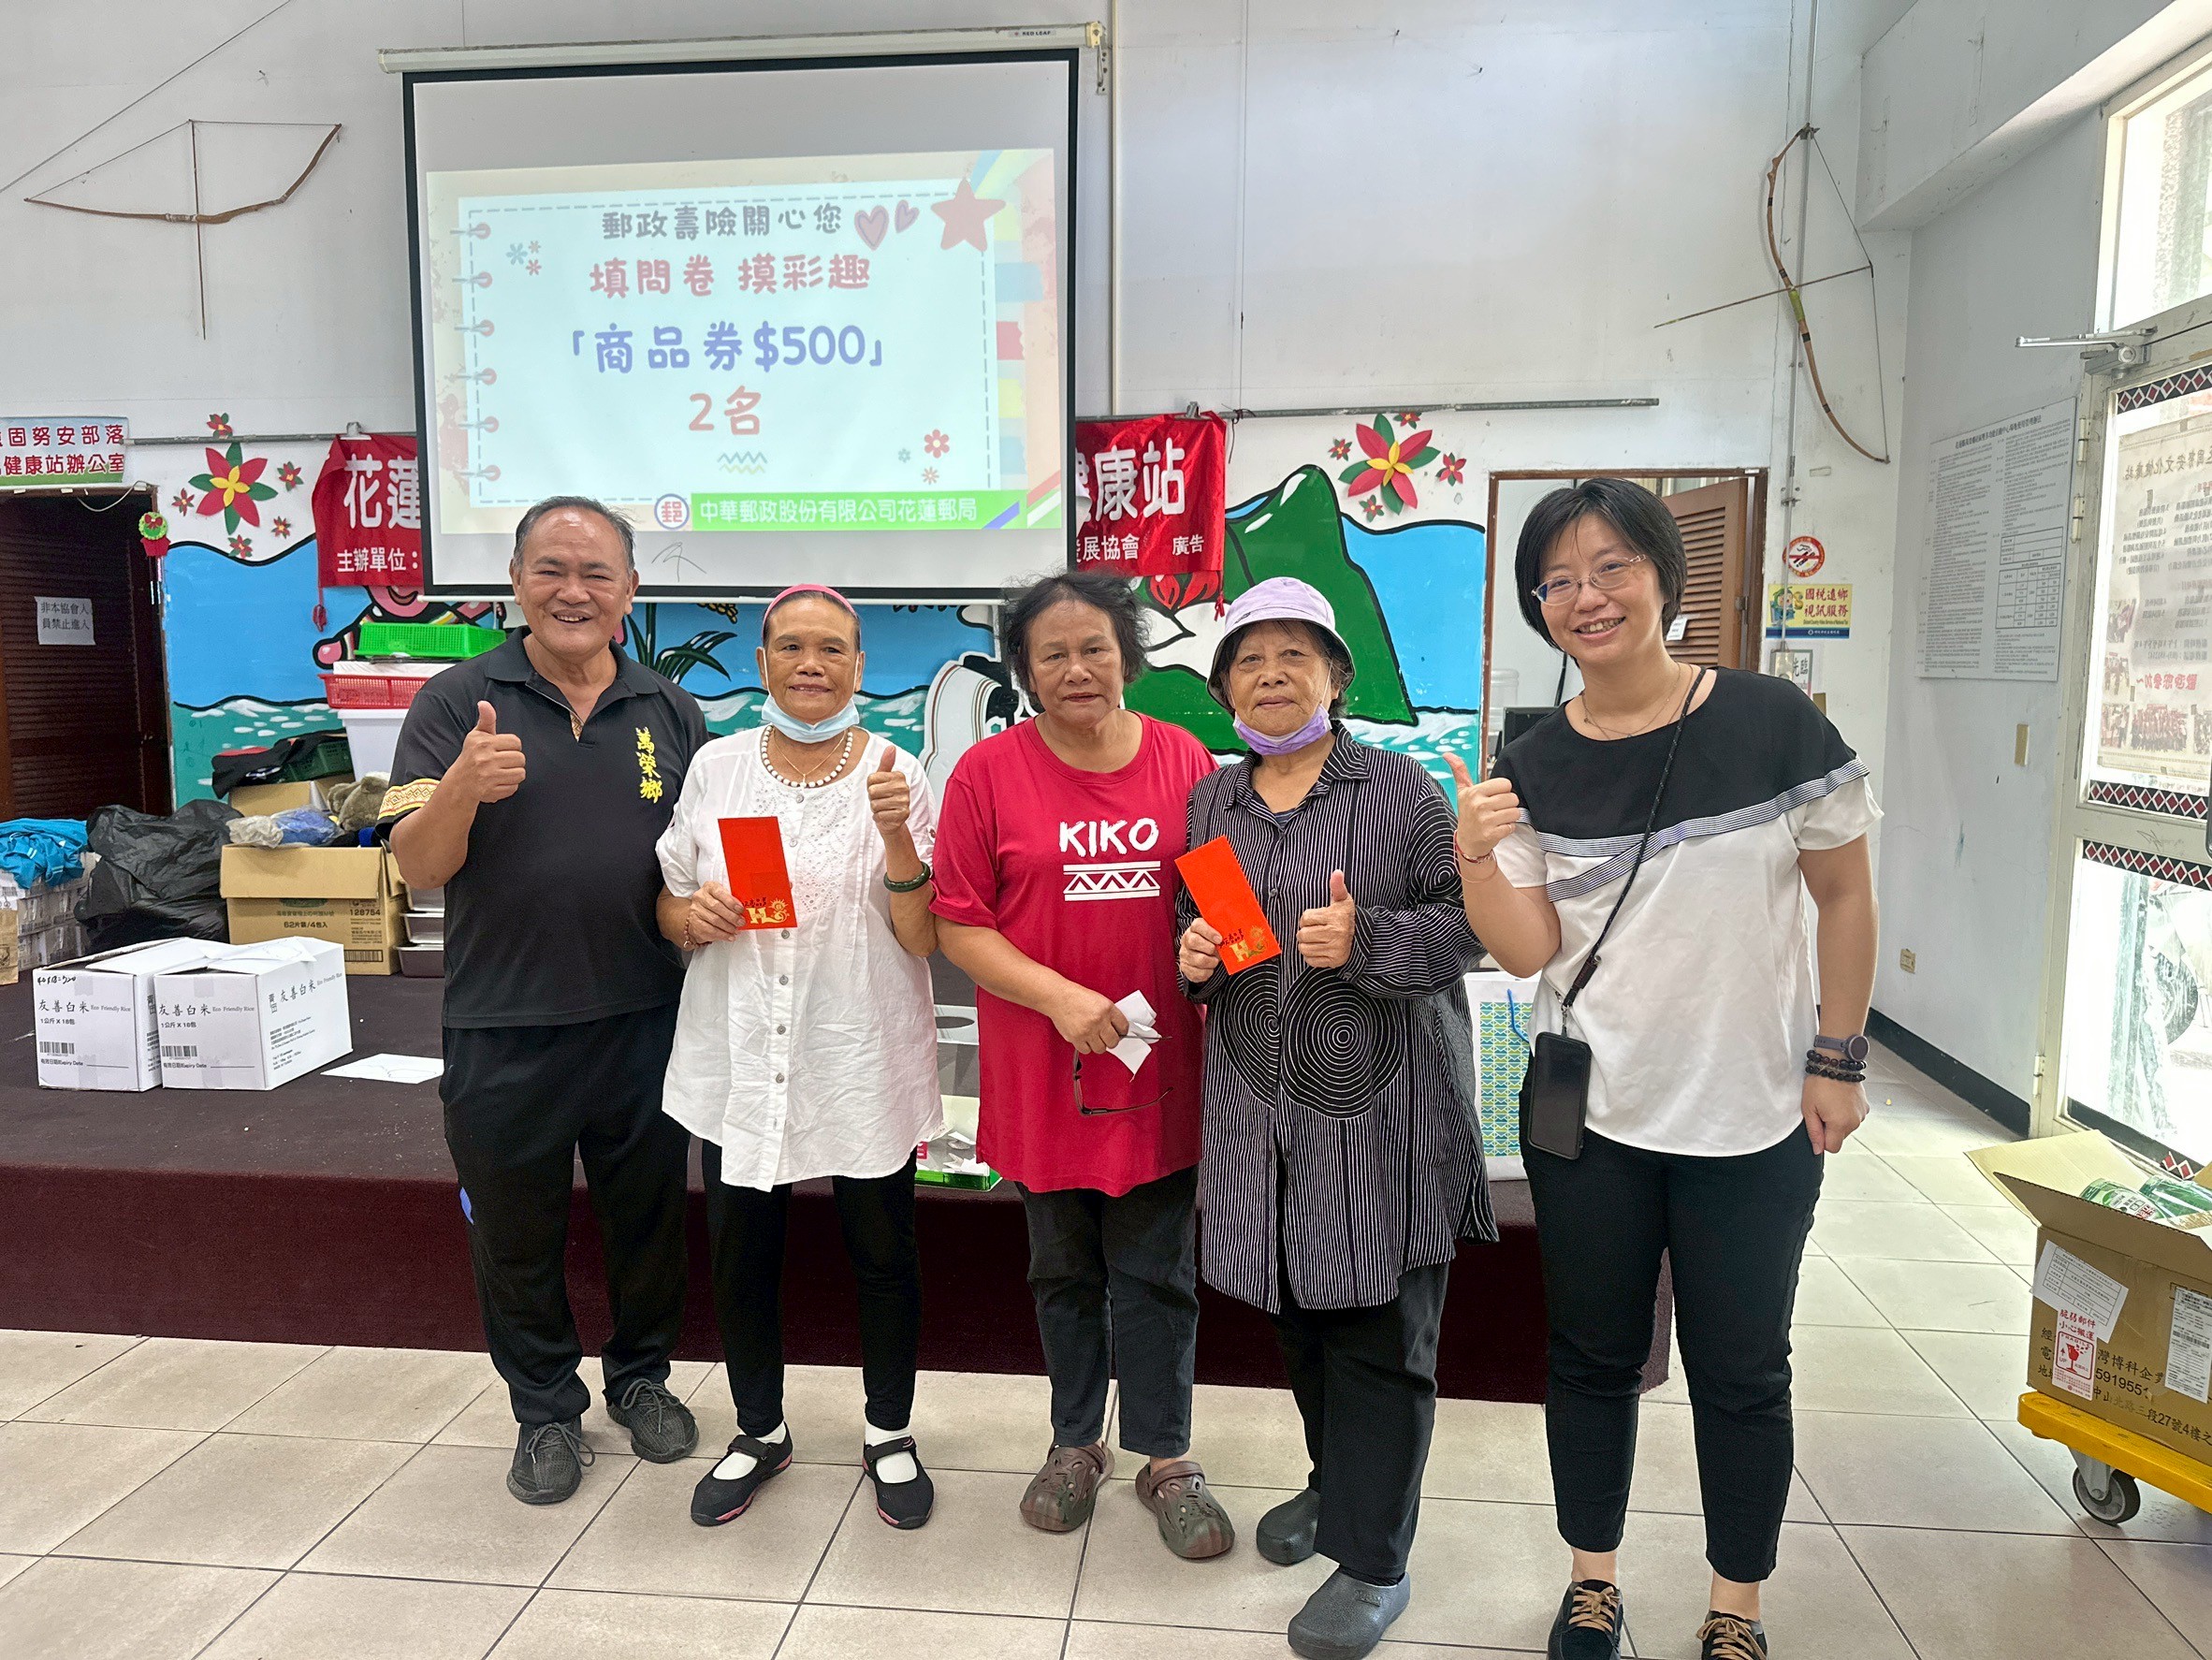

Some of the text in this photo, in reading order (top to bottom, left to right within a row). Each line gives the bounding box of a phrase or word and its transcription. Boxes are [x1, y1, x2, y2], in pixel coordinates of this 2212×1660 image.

[601, 203, 843, 240] 郵政壽險關心您
[589, 253, 870, 299] 填問卷 摸彩趣
[688, 385, 763, 436] 2名
[0, 424, 124, 447] 固努安部落
[0, 452, 125, 475] 健康站辦公室
[699, 498, 978, 524] 中華郵政股份有限公司花蓮郵局
[1171, 533, 1205, 556] 廣告
[1058, 817, 1160, 858] KIKO
[37, 998, 90, 1013] 友善白米
[158, 1003, 211, 1017] 友善白米
[2041, 1326, 2054, 1342] 經
[2041, 1345, 2055, 1361] 電
